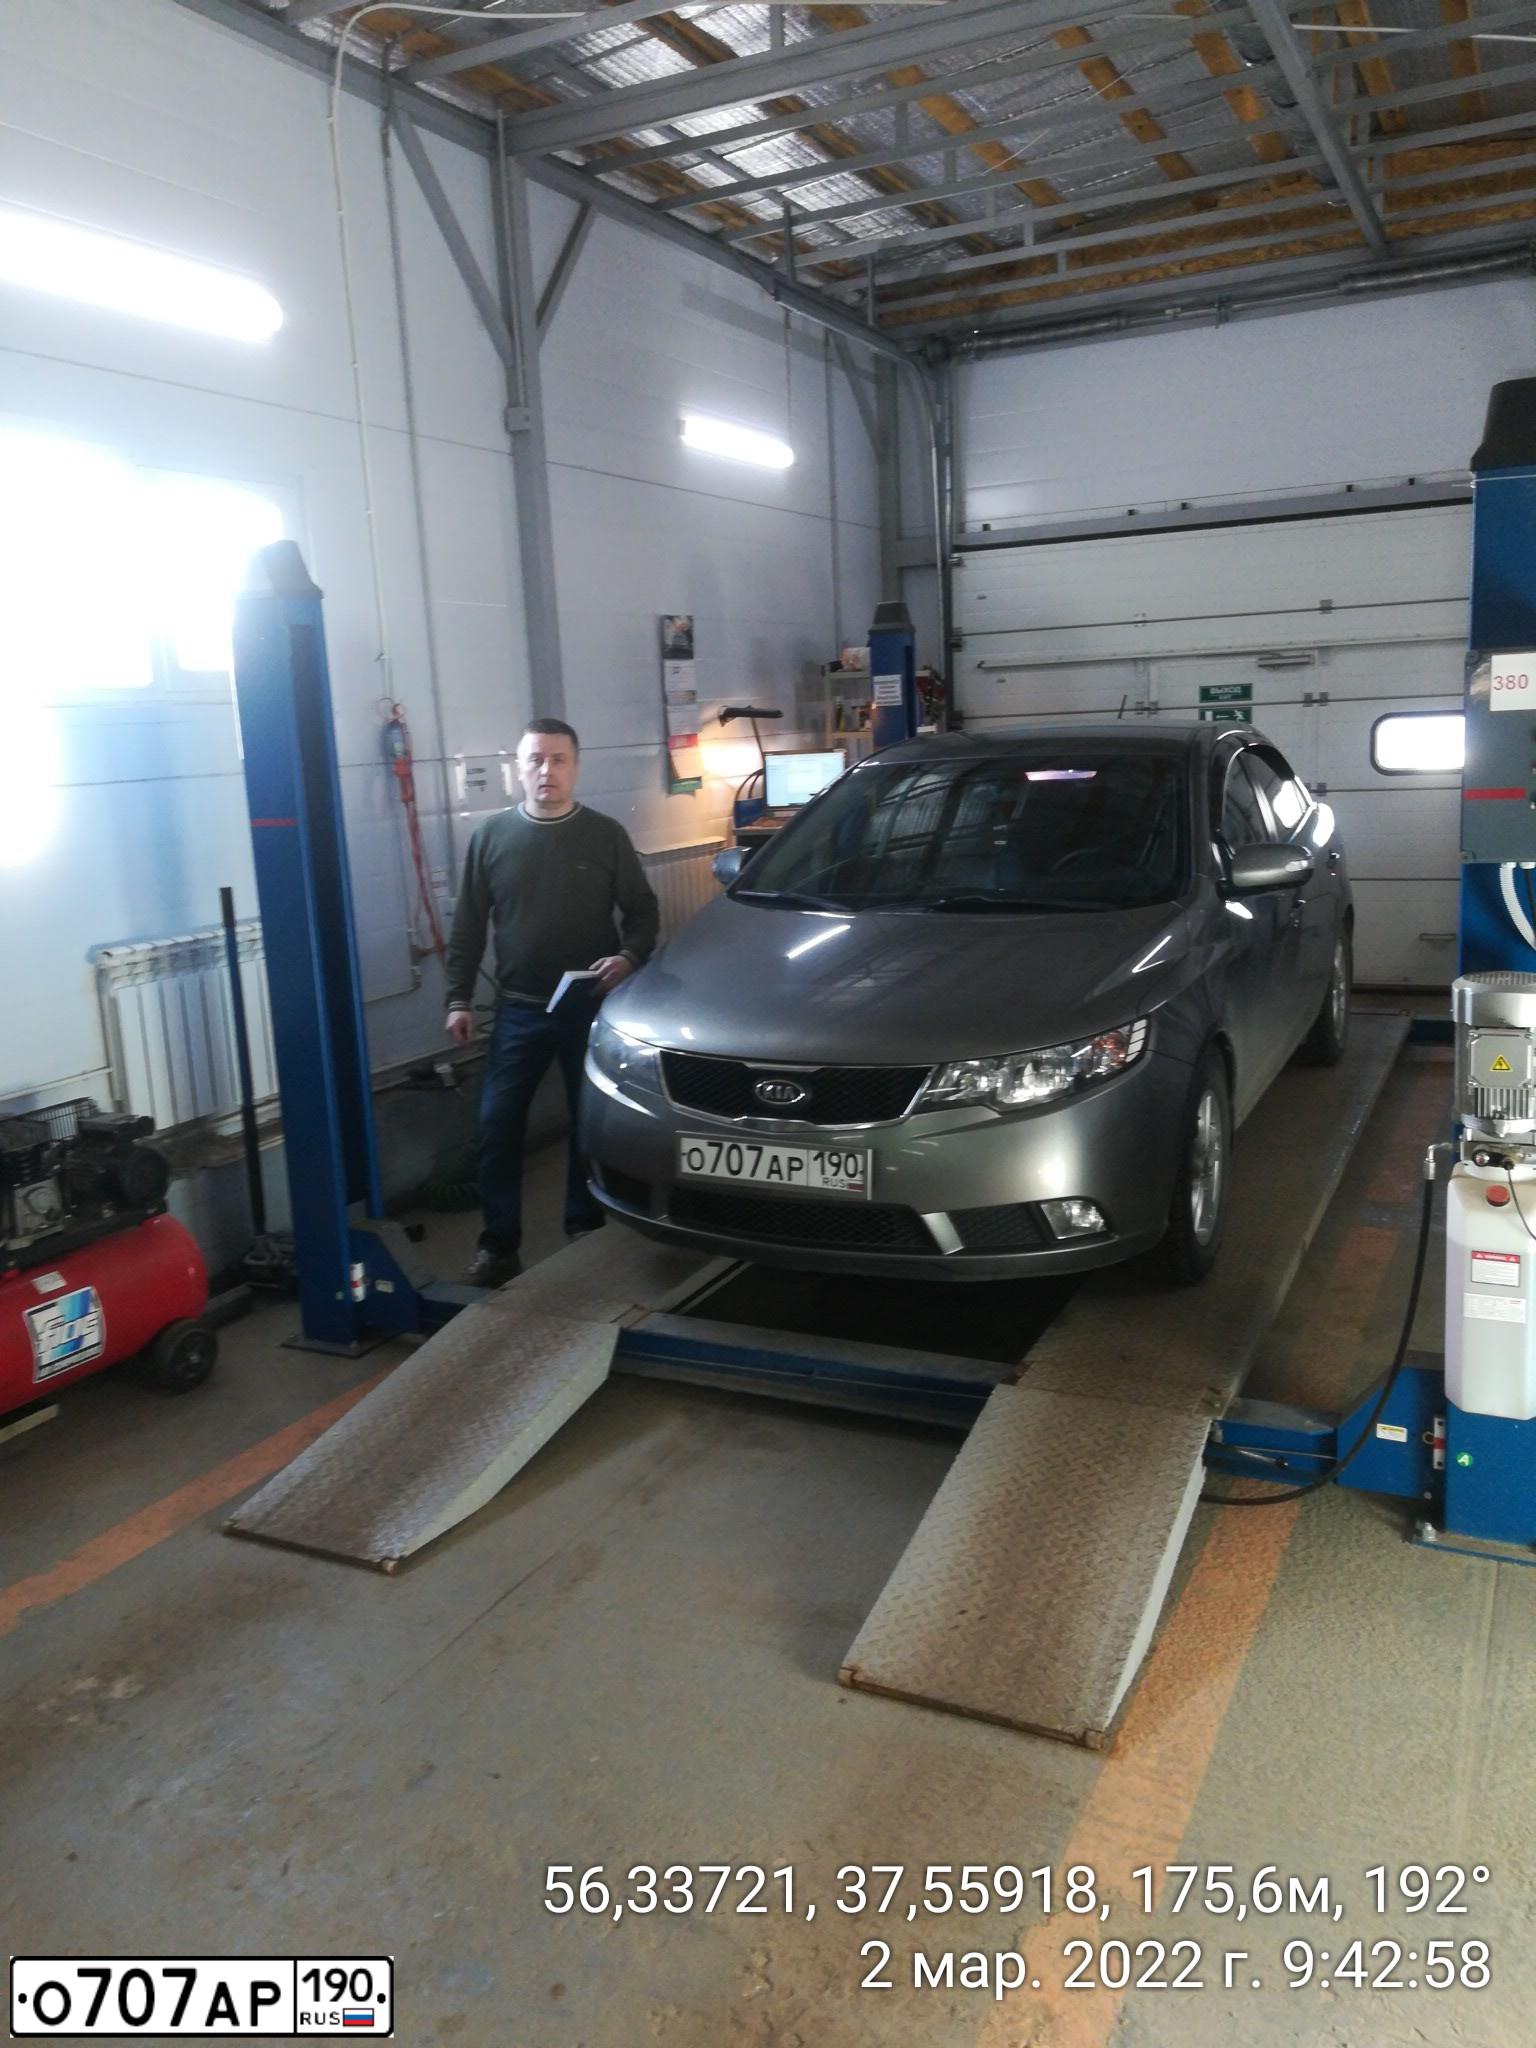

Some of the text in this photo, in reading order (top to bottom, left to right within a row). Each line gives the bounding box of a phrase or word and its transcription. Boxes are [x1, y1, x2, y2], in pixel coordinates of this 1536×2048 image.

[1493, 674, 1529, 691] 380
[762, 1084, 796, 1099] KIA
[812, 1151, 858, 1179] 190
[821, 1176, 848, 1189] RUS
